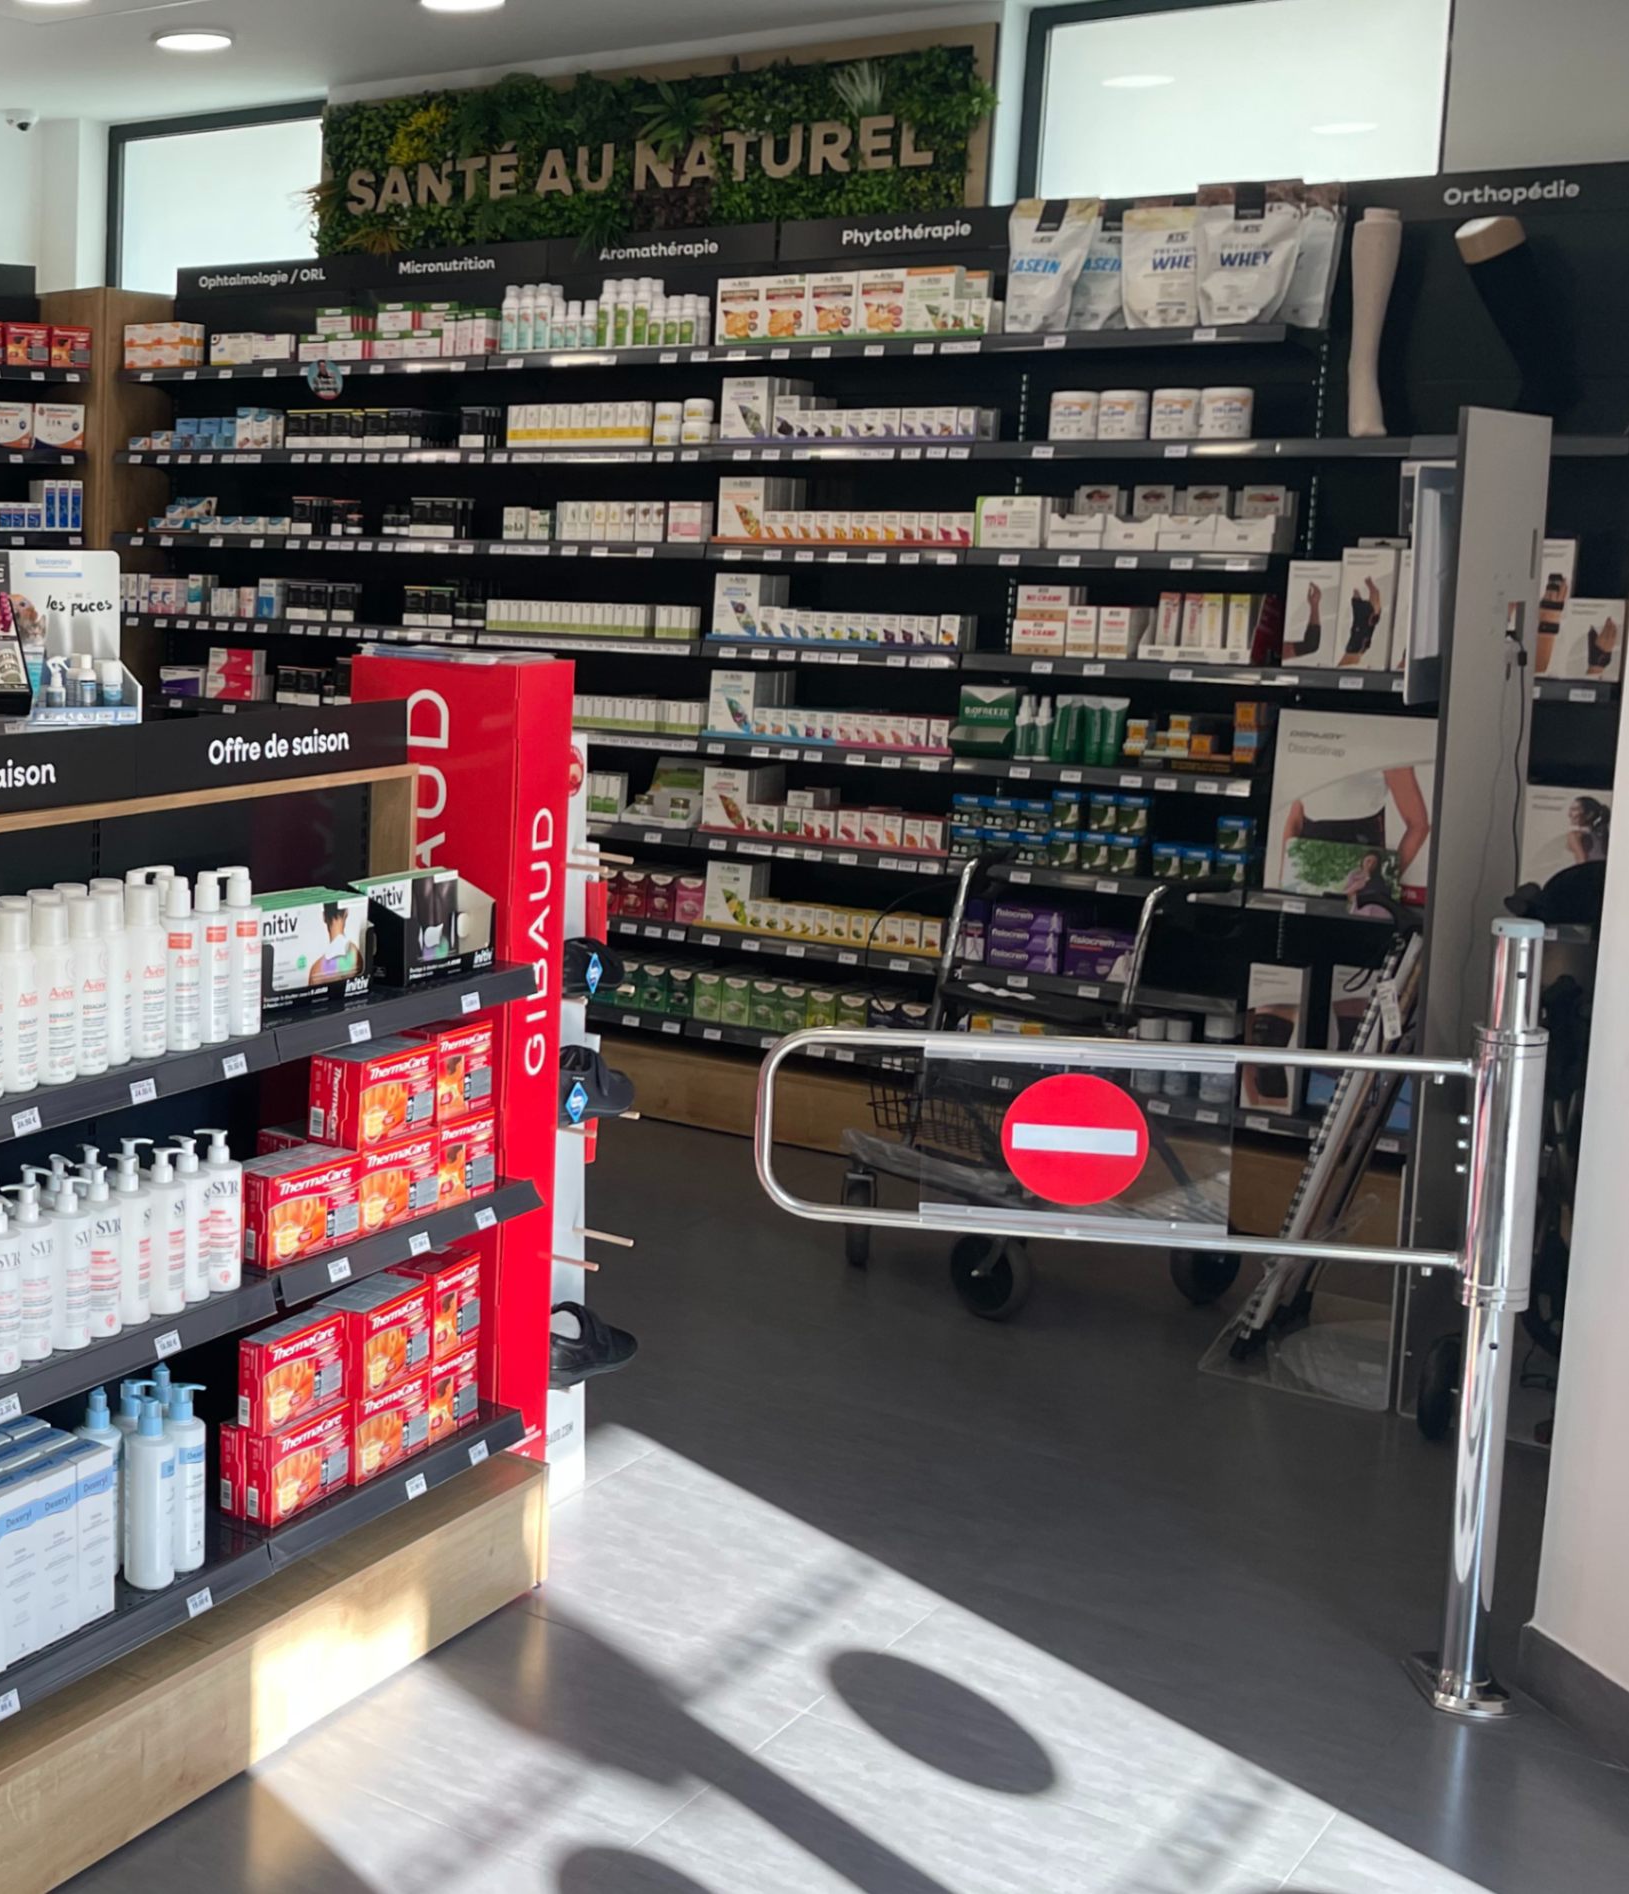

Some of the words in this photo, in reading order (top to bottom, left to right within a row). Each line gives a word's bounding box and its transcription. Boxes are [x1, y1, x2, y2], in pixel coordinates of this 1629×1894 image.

[346, 141, 520, 216] SANTÉ
[535, 142, 615, 199] AU
[634, 115, 935, 192] NATUREL
[1443, 179, 1580, 206] Orthopédie
[842, 220, 972, 247] Phytothérapie
[599, 238, 719, 262] Aromathérapie
[1220, 251, 1272, 268] WHEY
[198, 269, 289, 290] Ophtalmologie
[290, 269, 299, 286] /
[300, 267, 327, 283] ORL
[399, 256, 495, 275] Micronutrition
[46, 595, 65, 612] les
[72, 599, 113, 616] puces
[209, 738, 260, 765] Offre
[265, 734, 289, 760] de
[293, 729, 349, 755] saison
[262, 914, 298, 936] nitiv
[524, 806, 555, 1077] GIBAUD
[345, 975, 370, 991] initiv
[440, 1030, 492, 1054] ThermaCare
[370, 1054, 430, 1082] ThermaCare
[441, 1118, 494, 1143] ThermaCare
[366, 1140, 432, 1169] ThermaCare
[212, 1181, 239, 1196] SVR
[279, 1167, 352, 1197] ThermaCare
[95, 1218, 121, 1236] SVR
[436, 1262, 480, 1292] ThermaCare
[372, 1293, 425, 1331] ThermaCare
[272, 1326, 336, 1362] ThermaCare
[431, 1348, 477, 1378] ThermaCare
[364, 1379, 423, 1414] ThermaCare
[281, 1413, 343, 1453] ThermaCare
[83, 1475, 109, 1494] Dexeryl
[44, 1493, 72, 1514] Dexeryl
[6, 1509, 32, 1530] Dexeryl
